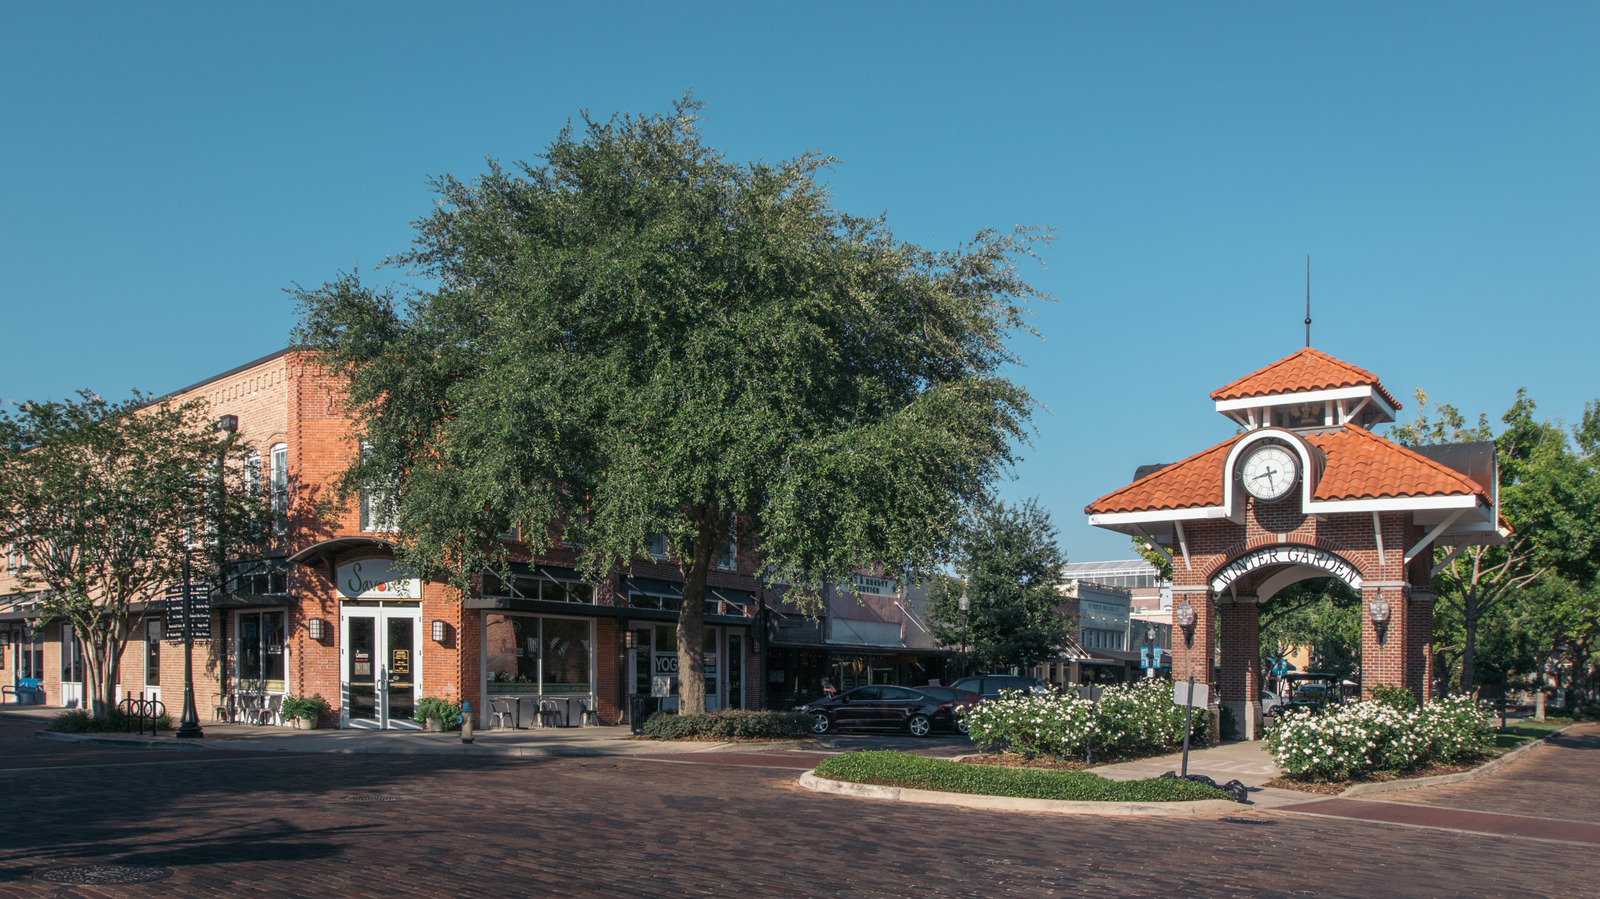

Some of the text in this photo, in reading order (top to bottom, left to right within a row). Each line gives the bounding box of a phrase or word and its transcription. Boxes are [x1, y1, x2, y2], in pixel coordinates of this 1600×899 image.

[1217, 546, 1360, 586] WINTER GARDEN
[855, 585, 880, 594] ERVICE
